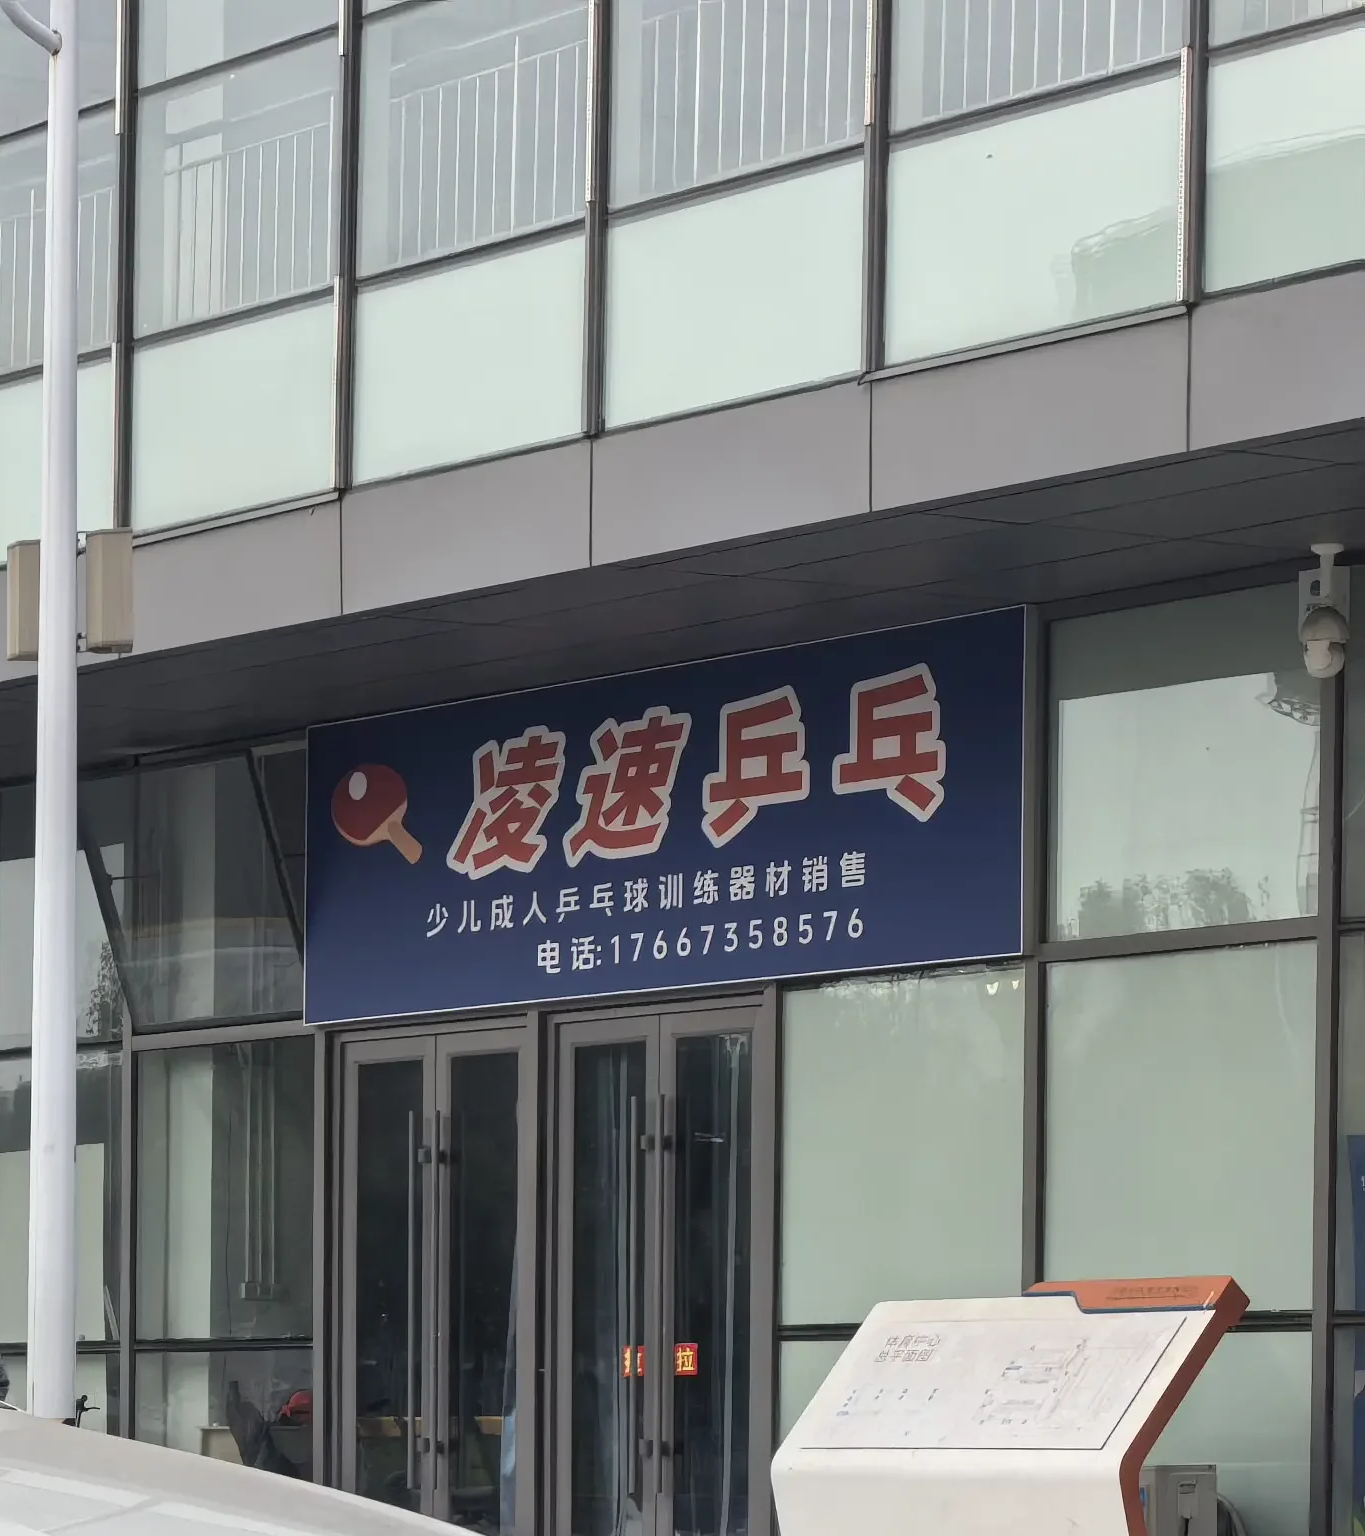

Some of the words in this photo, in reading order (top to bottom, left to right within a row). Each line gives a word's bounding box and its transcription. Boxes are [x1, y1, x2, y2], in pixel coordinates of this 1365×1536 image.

[447, 663, 946, 880] 凌速乒乓
[426, 851, 866, 938] 少儿成人乒乓球训练器材销售
[676, 1347, 694, 1371] 拉
